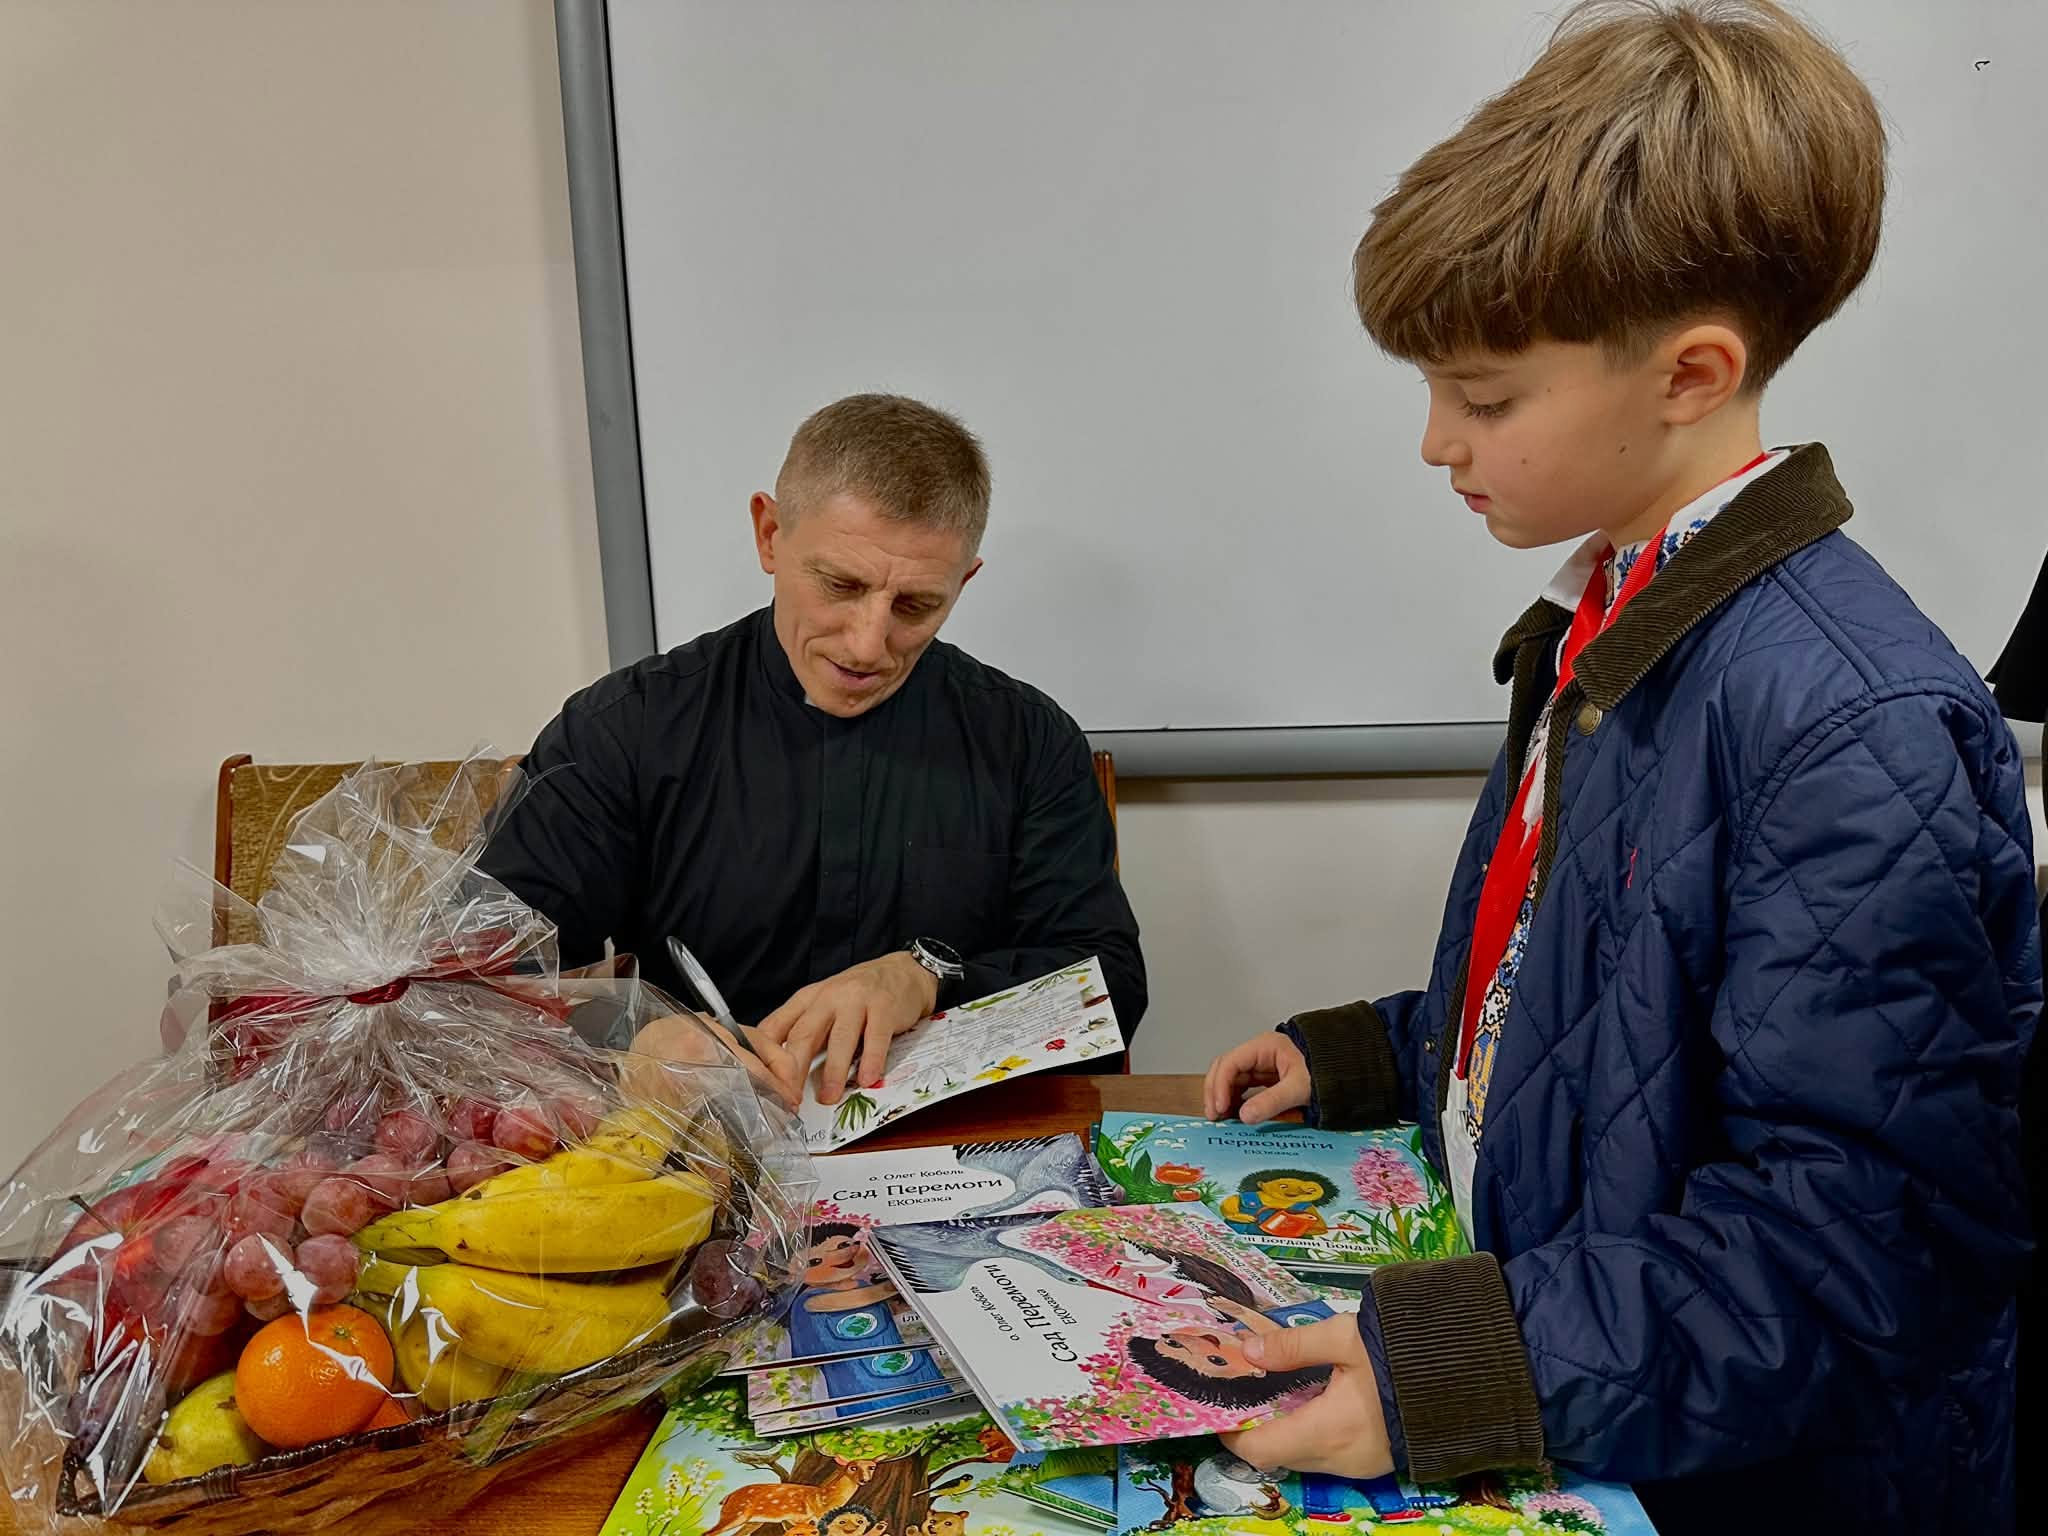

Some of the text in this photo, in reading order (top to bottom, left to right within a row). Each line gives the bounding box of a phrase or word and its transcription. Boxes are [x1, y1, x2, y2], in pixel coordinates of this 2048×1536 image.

[1207, 1137, 1335, 1150] Первоцвіти
[884, 1172, 915, 1181] Олег
[920, 1169, 964, 1178] Кобель
[832, 1179, 1003, 1201] Сад Перемоги
[887, 1196, 953, 1207] ЕКОказка
[1261, 1236, 1321, 1248] Богдани
[1325, 1240, 1379, 1252] Бондар
[970, 1286, 996, 1312] Кобель
[1037, 1288, 1078, 1325] ЕКОказка
[983, 1264, 1078, 1362] Сад Перемоги
[990, 1311, 1013, 1332] Олег
